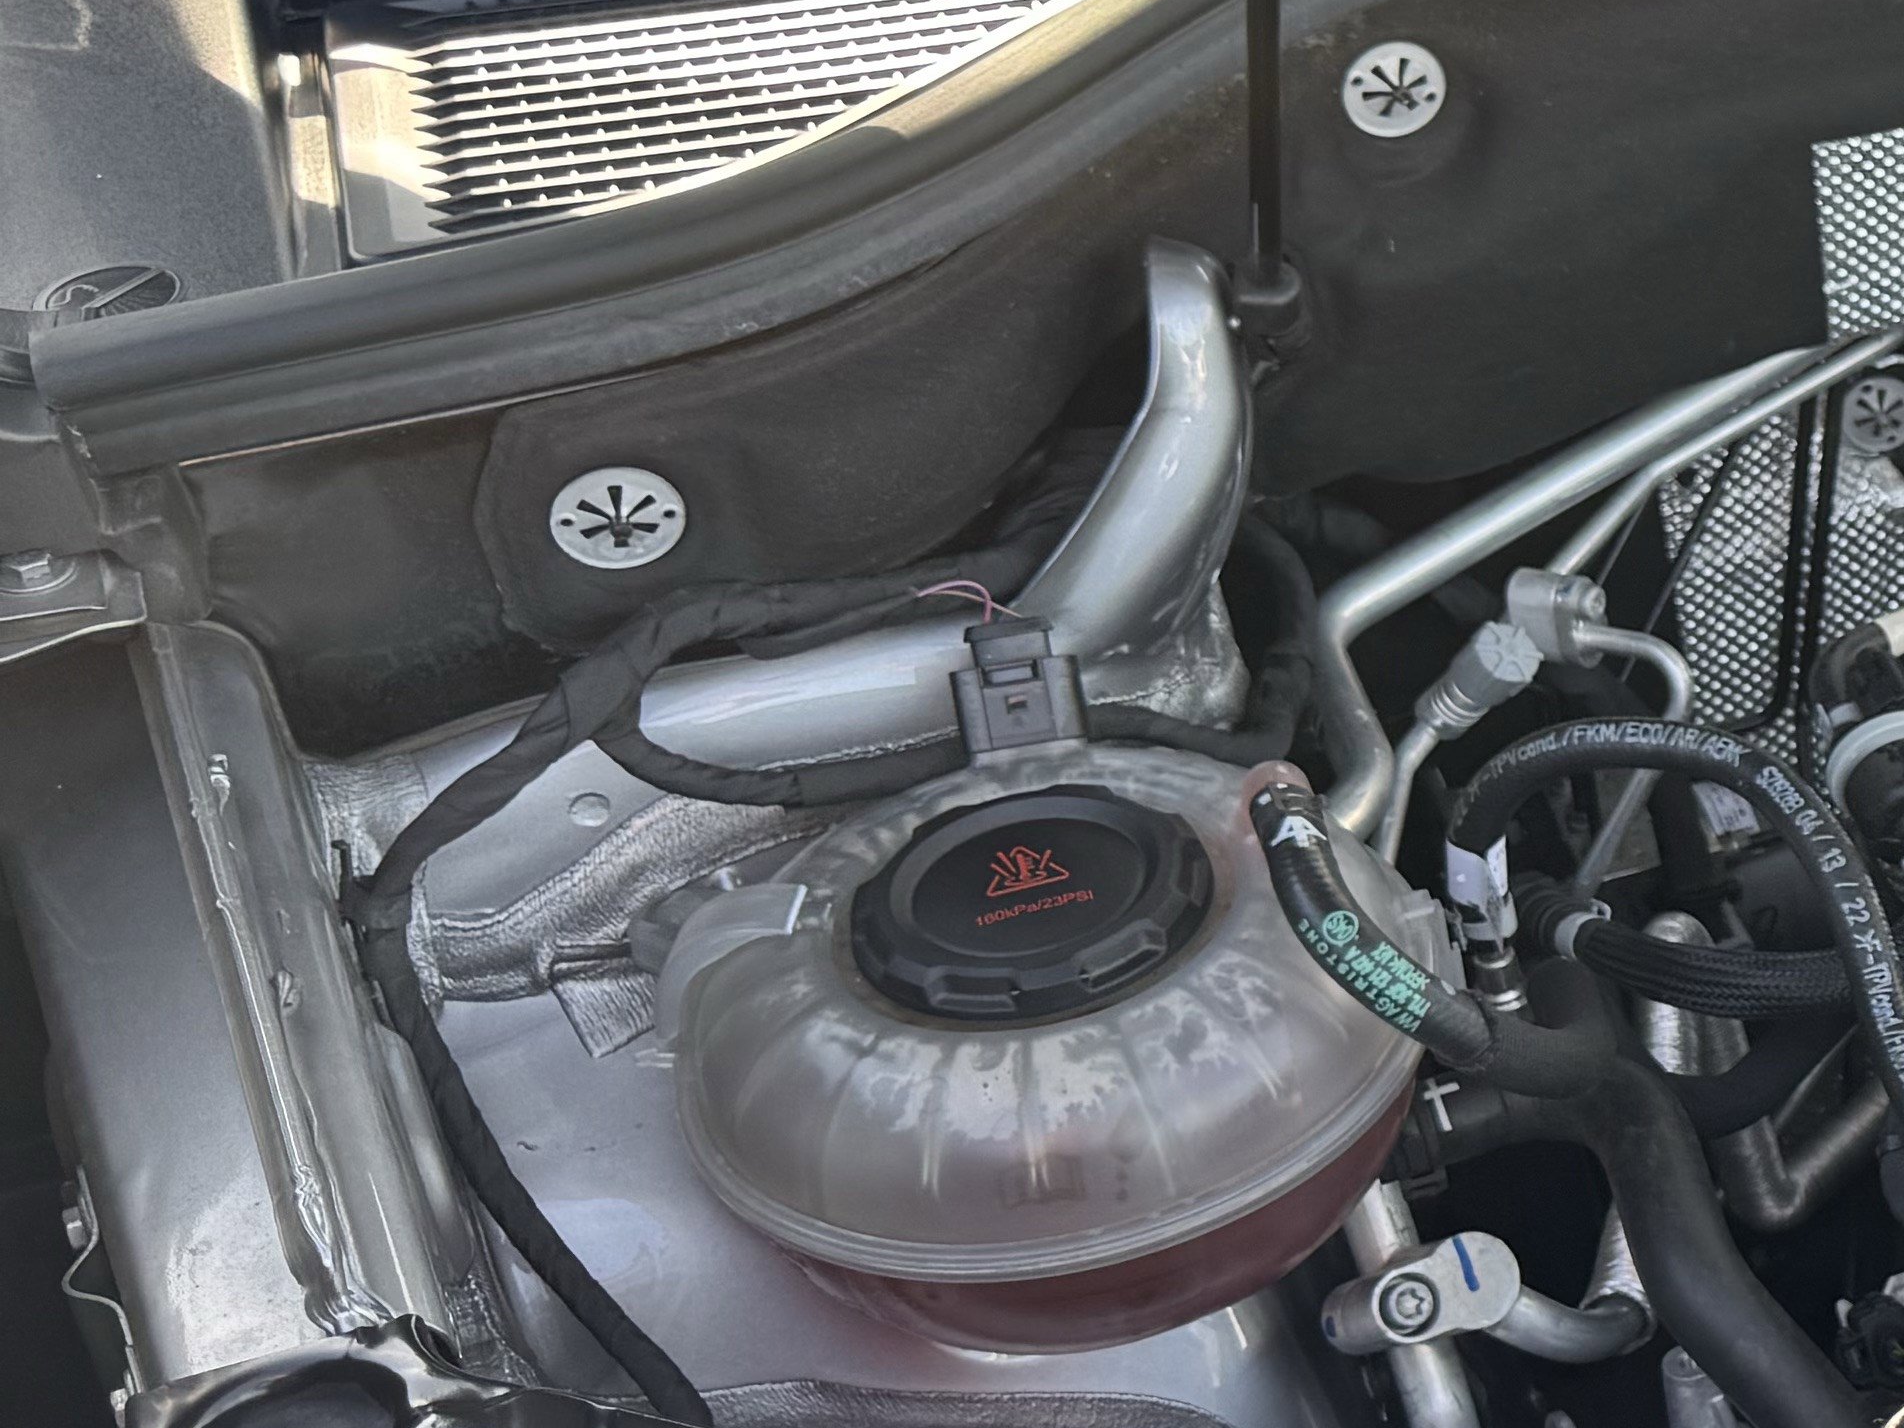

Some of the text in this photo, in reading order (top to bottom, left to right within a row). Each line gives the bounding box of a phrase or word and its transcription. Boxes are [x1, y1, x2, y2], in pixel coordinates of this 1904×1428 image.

[1819, 847, 1846, 872] 13
[1841, 897, 1870, 926] 22
[1298, 918, 1377, 1000] TRISTONE
